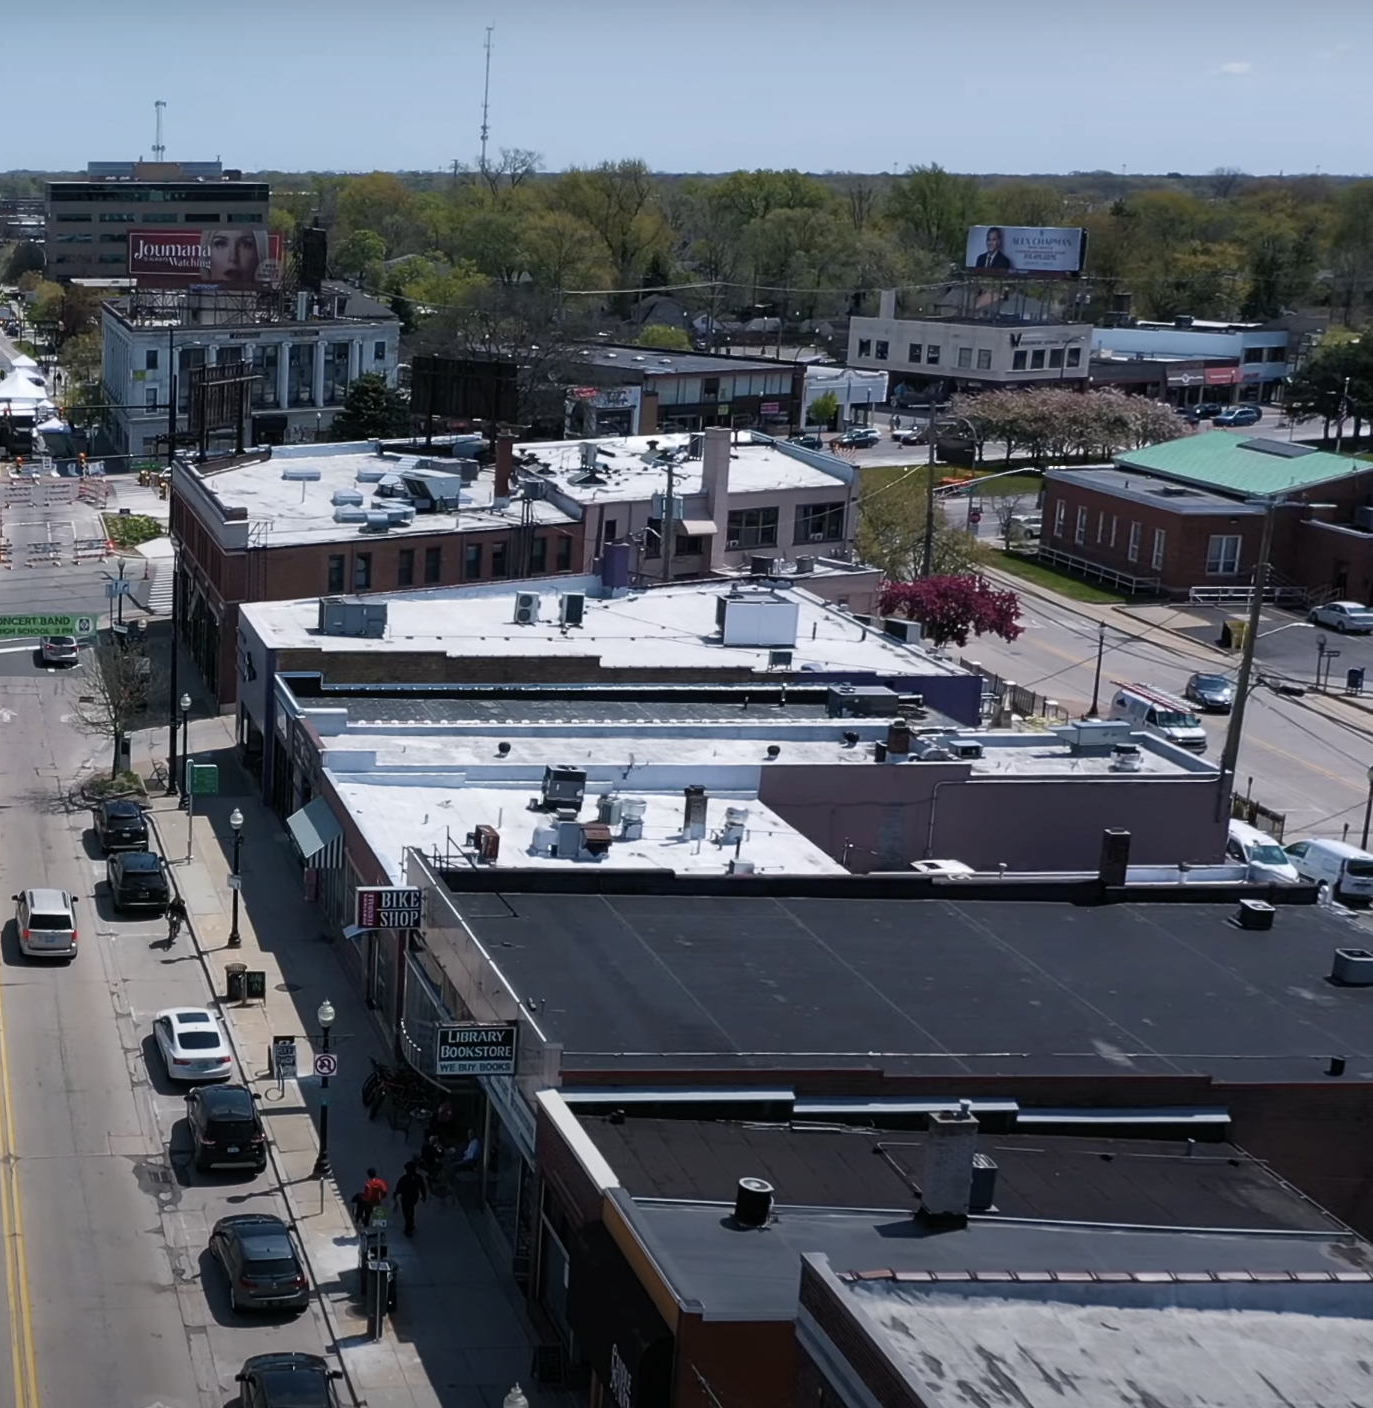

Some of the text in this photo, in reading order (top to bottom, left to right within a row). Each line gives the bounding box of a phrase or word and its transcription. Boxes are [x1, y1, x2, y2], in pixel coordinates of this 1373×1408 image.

[134, 240, 211, 259] Joumana
[169, 258, 211, 269] Watching
[40, 617, 70, 625] BAND
[381, 891, 420, 908] BIKE
[380, 911, 418, 927] SHOP
[448, 1030, 505, 1043] LIBRARY
[441, 1045, 512, 1058] BOOKSTORE
[440, 1062, 511, 1072] WE BUY BOOKS
